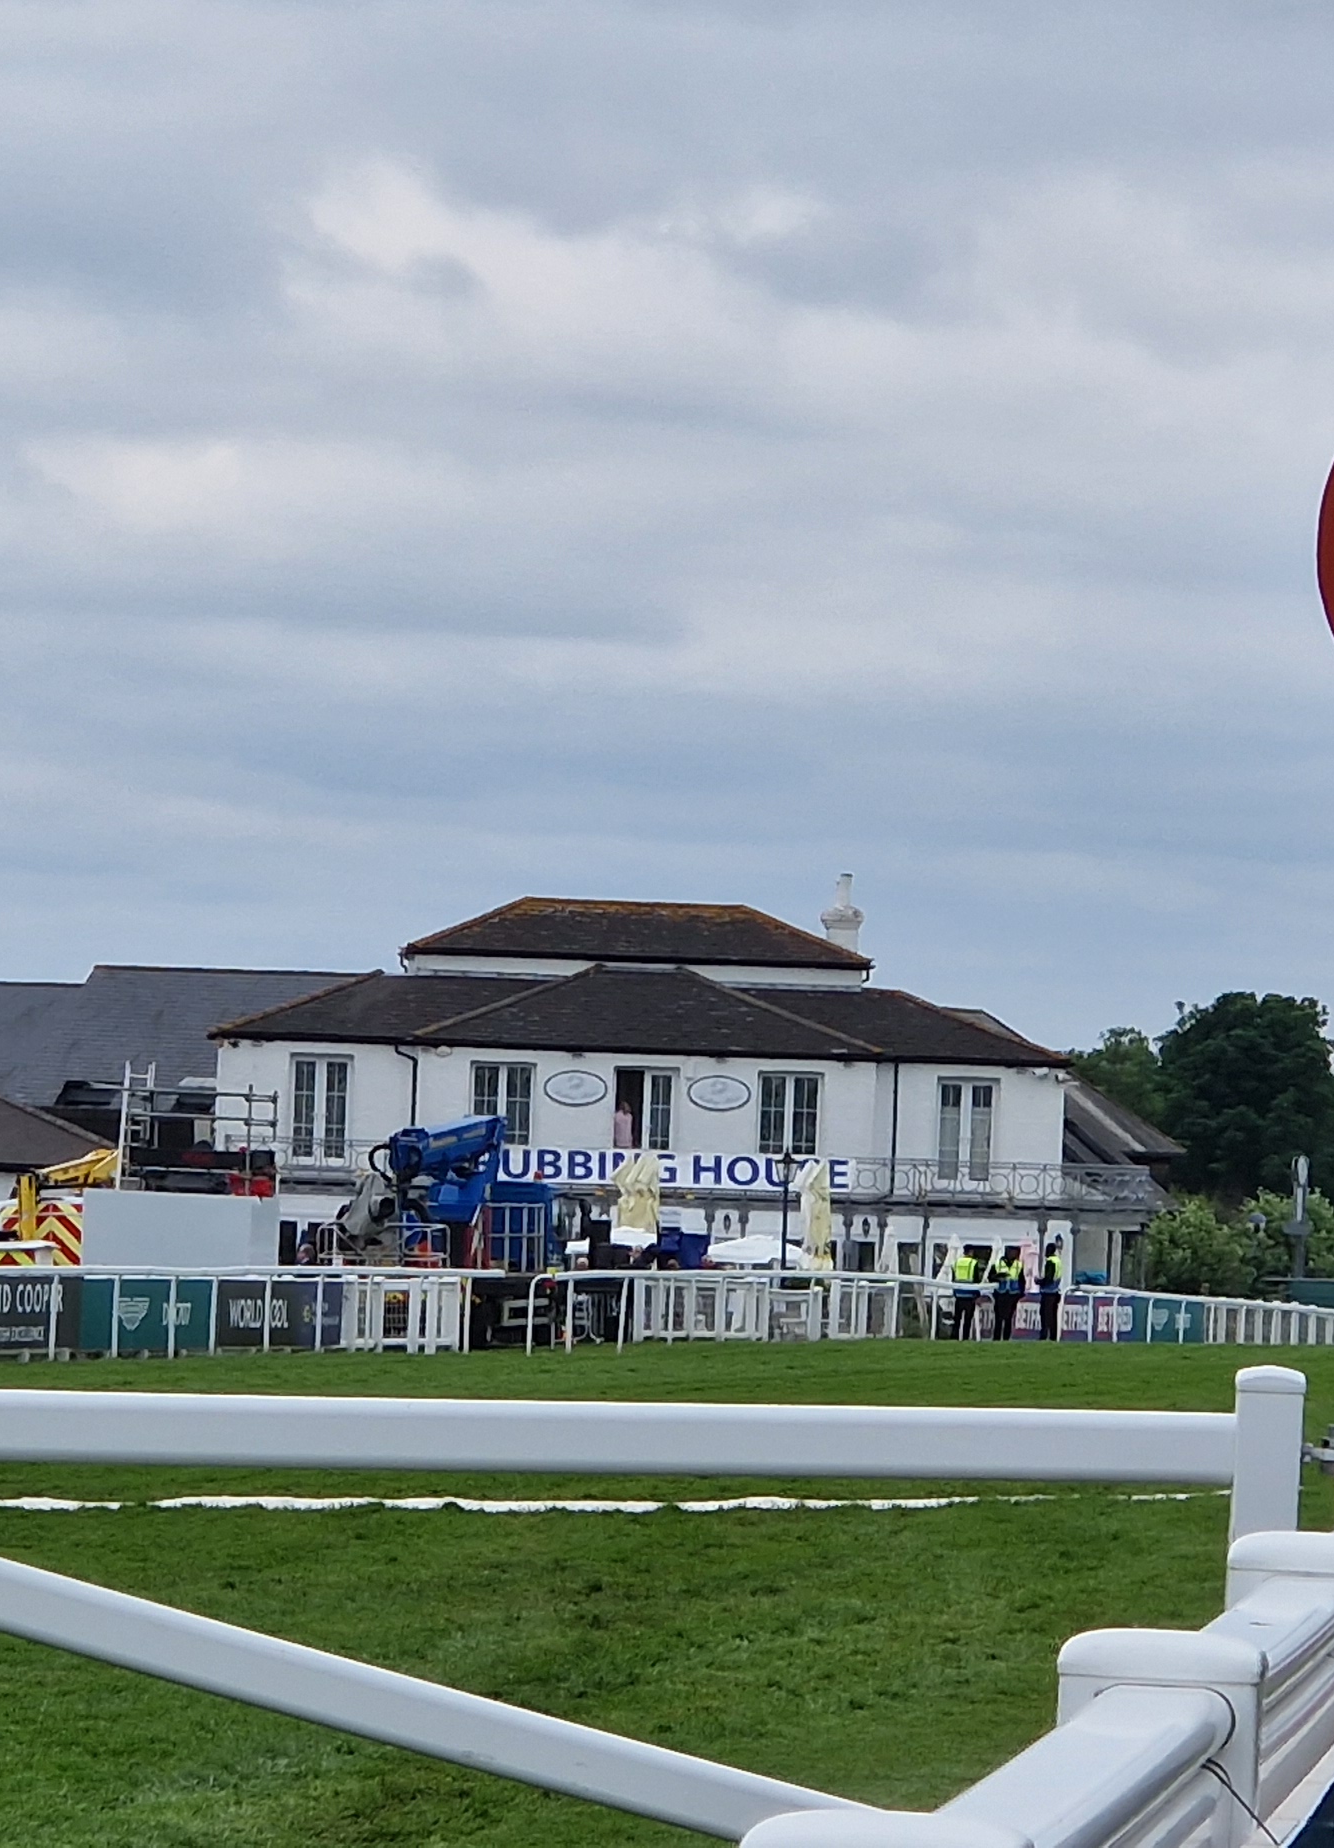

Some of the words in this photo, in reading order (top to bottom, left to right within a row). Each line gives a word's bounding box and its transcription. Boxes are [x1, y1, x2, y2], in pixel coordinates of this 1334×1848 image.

[502, 1149, 677, 1183] UBBIG
[693, 1155, 849, 1189] HOUE
[16, 1283, 64, 1314] COOPR
[270, 1299, 288, 1328] OOL
